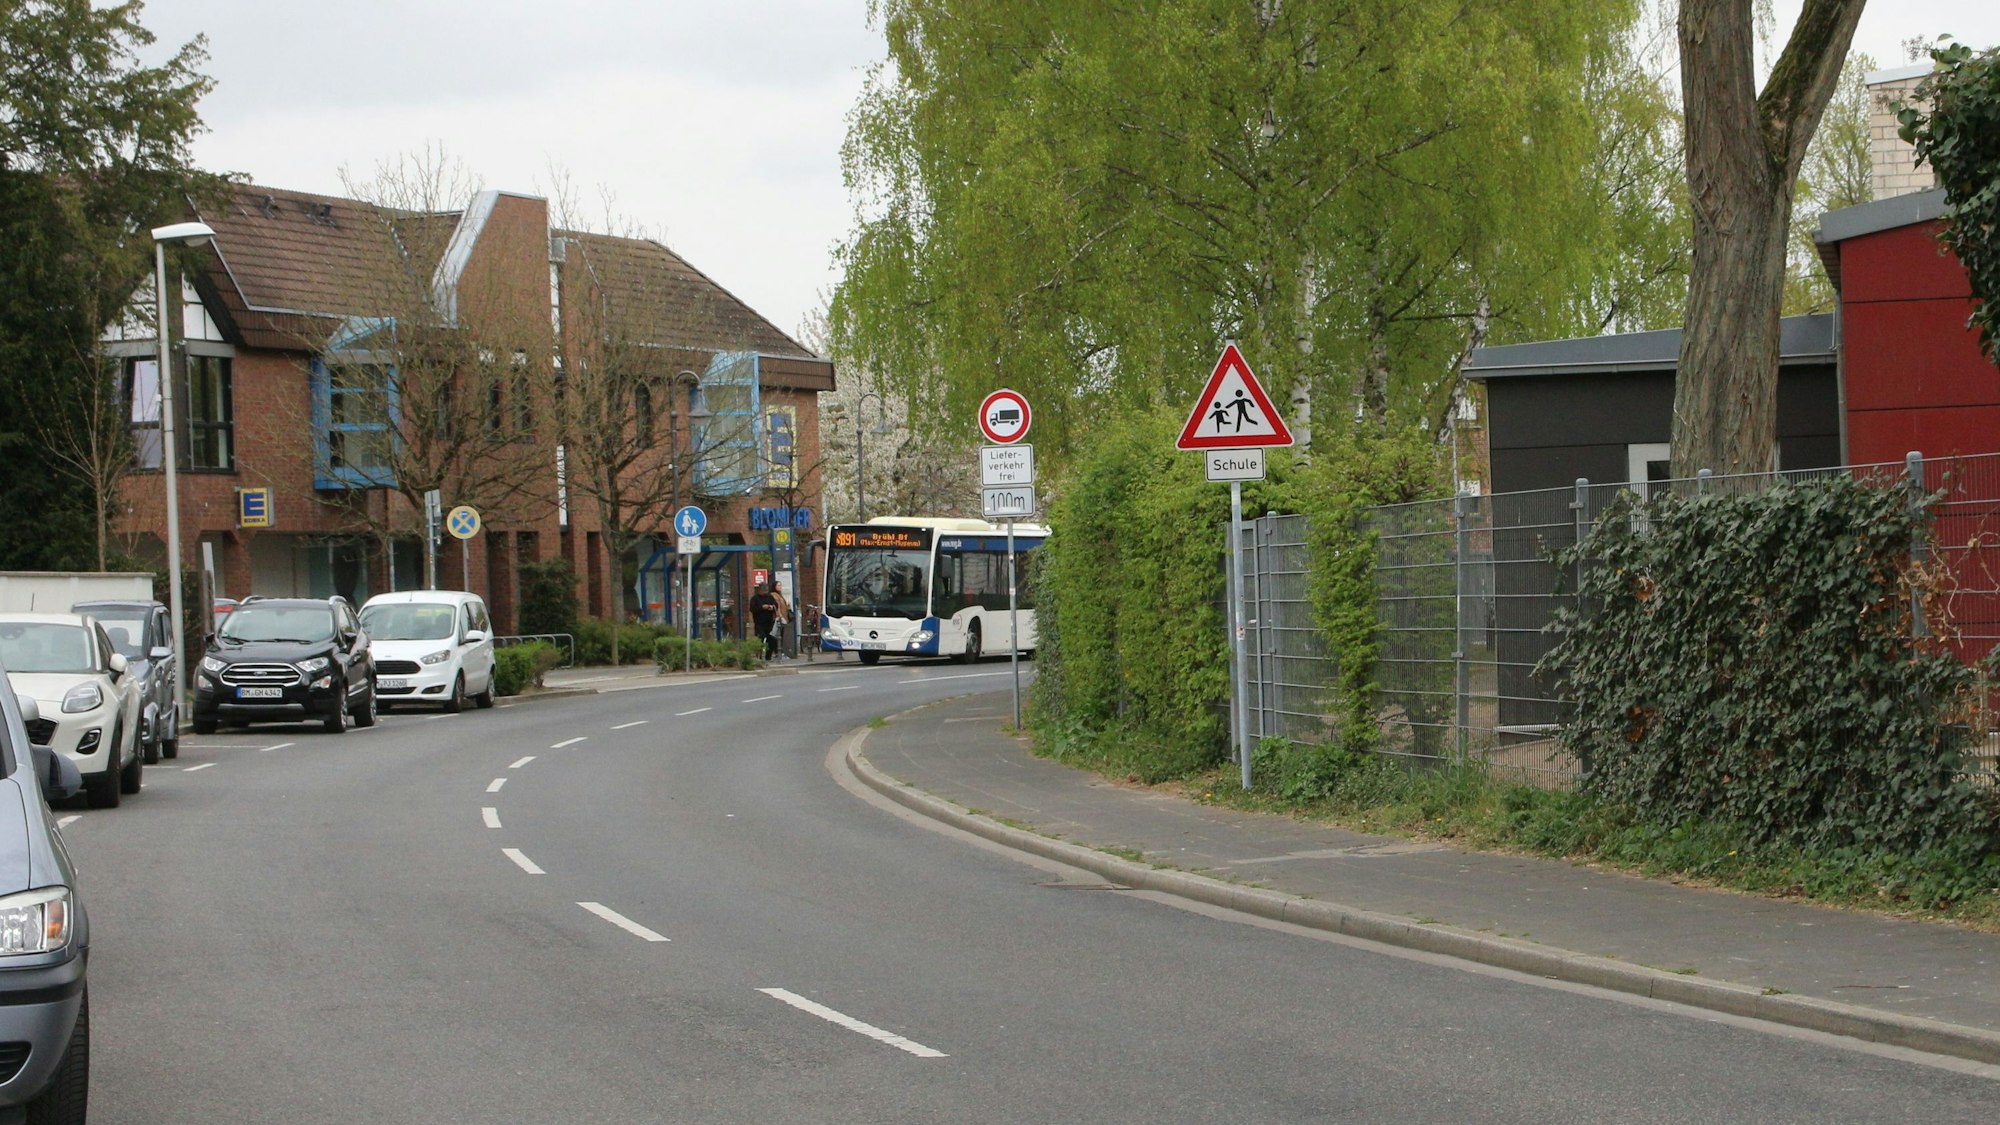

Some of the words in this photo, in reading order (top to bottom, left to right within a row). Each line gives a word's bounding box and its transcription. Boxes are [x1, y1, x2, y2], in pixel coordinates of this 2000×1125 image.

[990, 451, 1022, 460] Liefer-
[988, 461, 1024, 471] verkehr
[1213, 458, 1257, 471] Schule
[999, 471, 1016, 480] frei
[990, 492, 1026, 511] 100m
